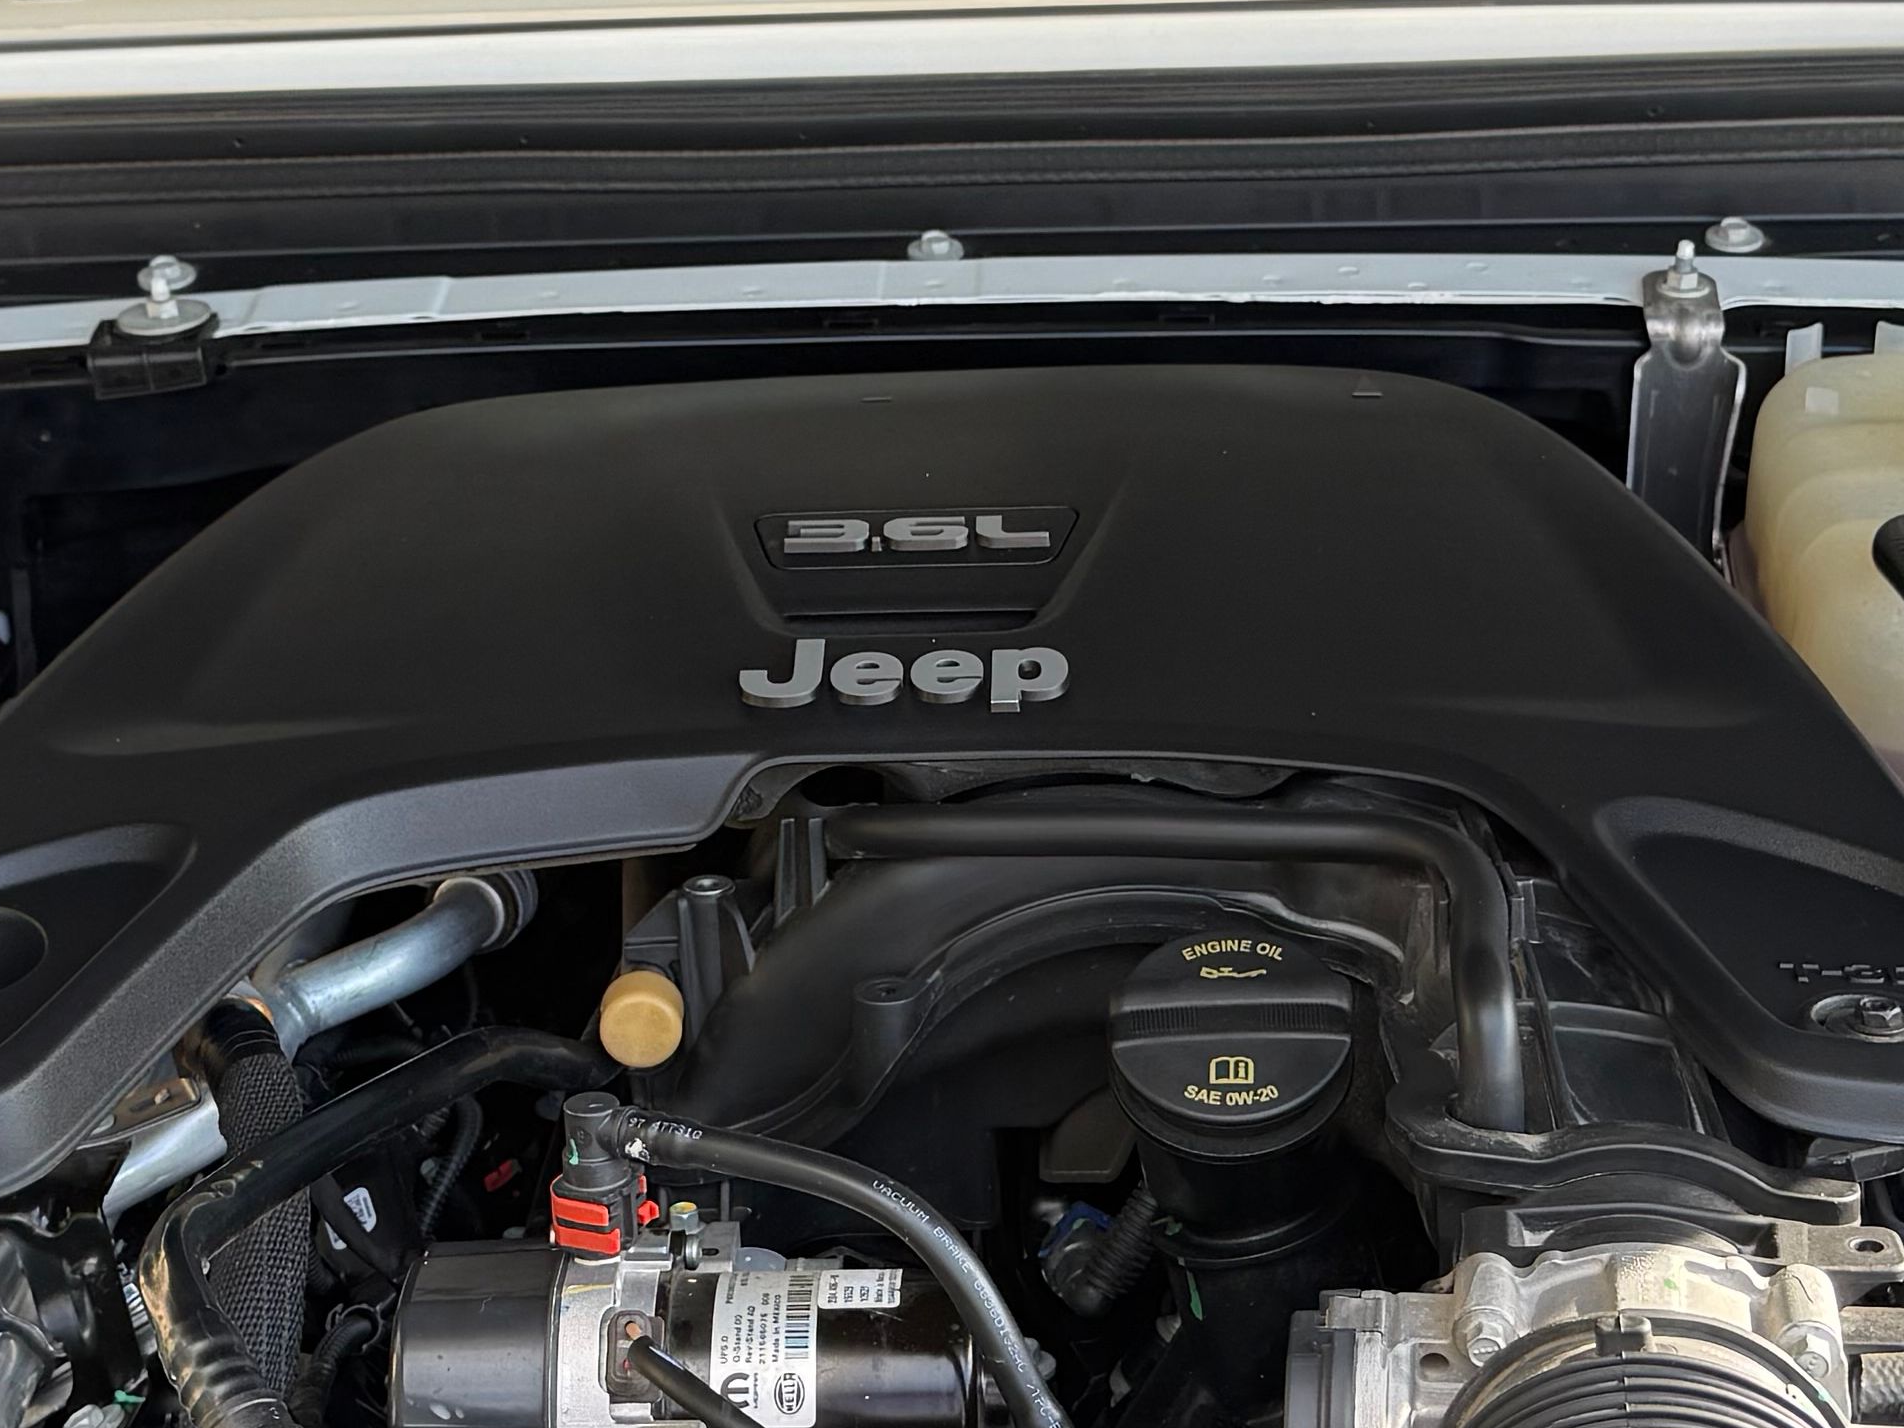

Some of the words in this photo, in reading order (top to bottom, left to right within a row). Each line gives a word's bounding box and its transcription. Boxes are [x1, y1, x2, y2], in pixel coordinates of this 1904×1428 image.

[783, 514, 1052, 554] 3.6L
[738, 637, 1070, 713] Jeep
[1181, 939, 1253, 961] ENGINE
[1256, 941, 1286, 961] OIL
[1184, 1084, 1221, 1106] SAE
[1226, 1084, 1280, 1107] 0W-20
[872, 1179, 930, 1223] VACUUM
[933, 1226, 970, 1273] BRAKE
[782, 1372, 796, 1412] HELLA
